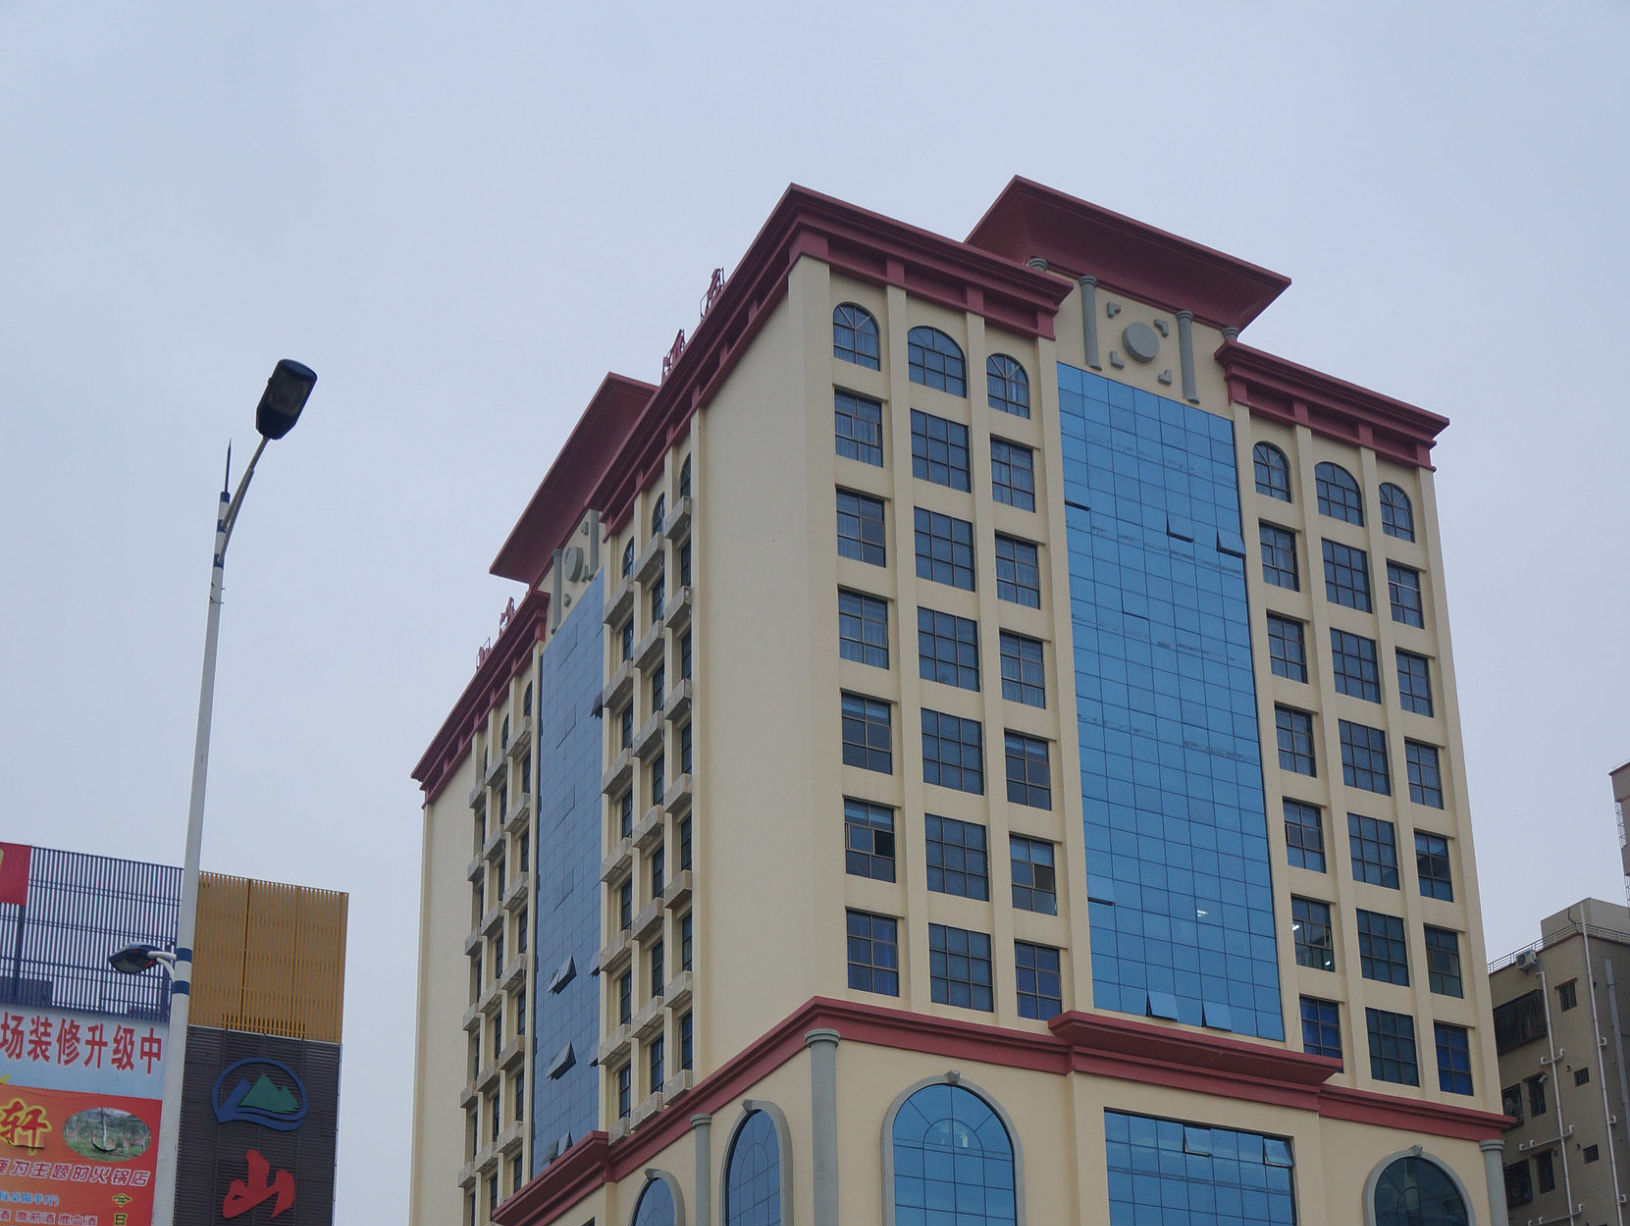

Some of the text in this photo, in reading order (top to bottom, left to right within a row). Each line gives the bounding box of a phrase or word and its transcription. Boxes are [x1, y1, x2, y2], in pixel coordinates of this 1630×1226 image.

[0, 1012, 162, 1075] 场装修升级中
